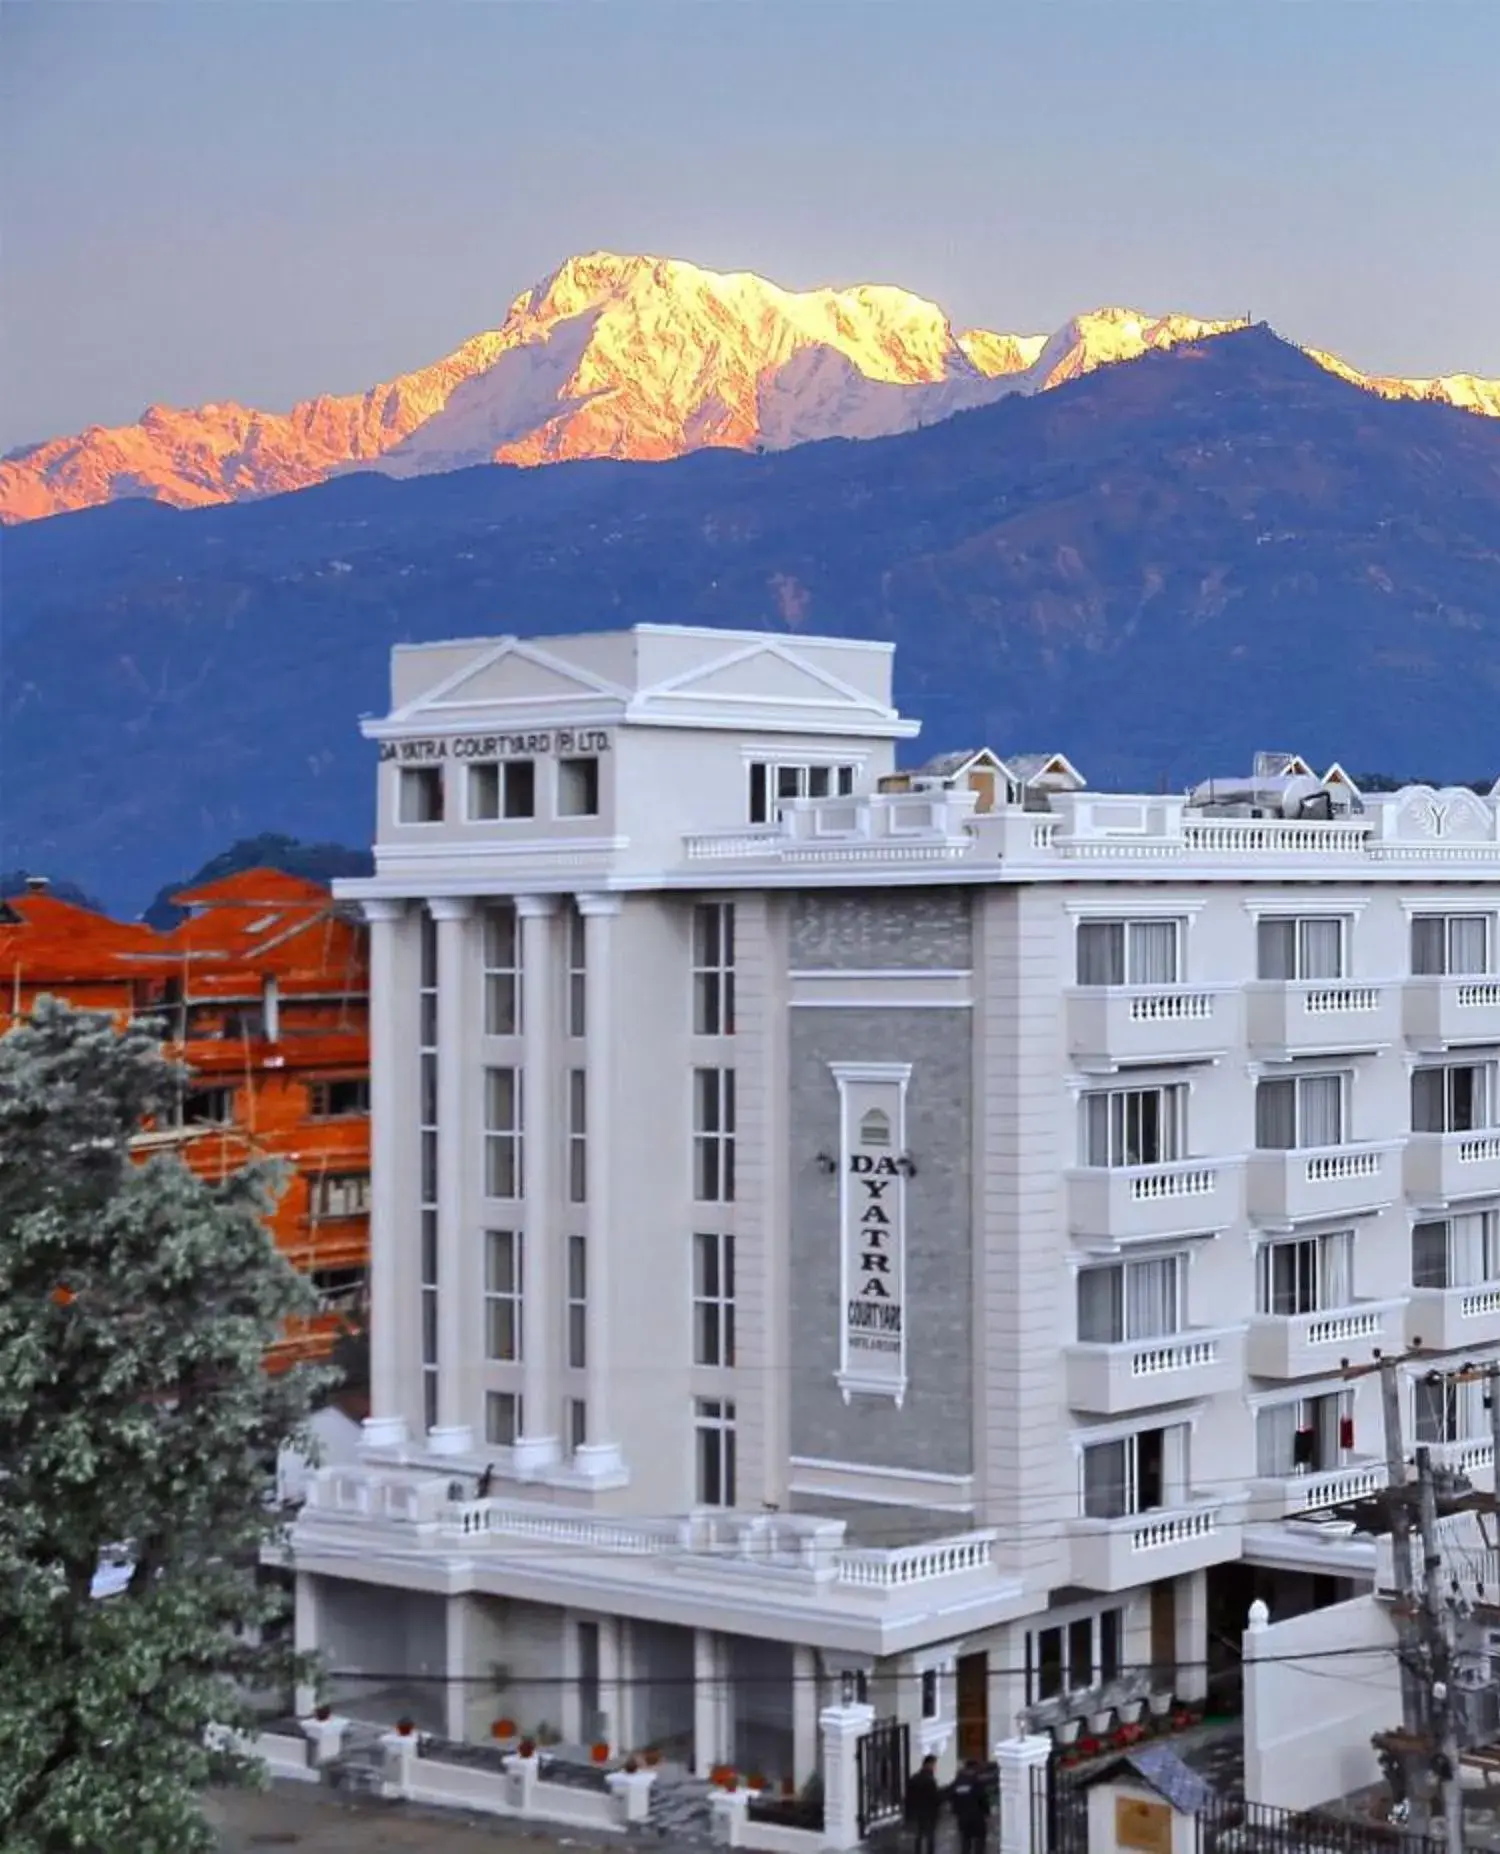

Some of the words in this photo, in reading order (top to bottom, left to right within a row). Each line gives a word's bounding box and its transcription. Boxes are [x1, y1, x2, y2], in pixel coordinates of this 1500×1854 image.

[400, 740, 447, 760] YATRA
[454, 733, 550, 758] COURTYARD
[848, 1301, 901, 1332] COURTYARD
